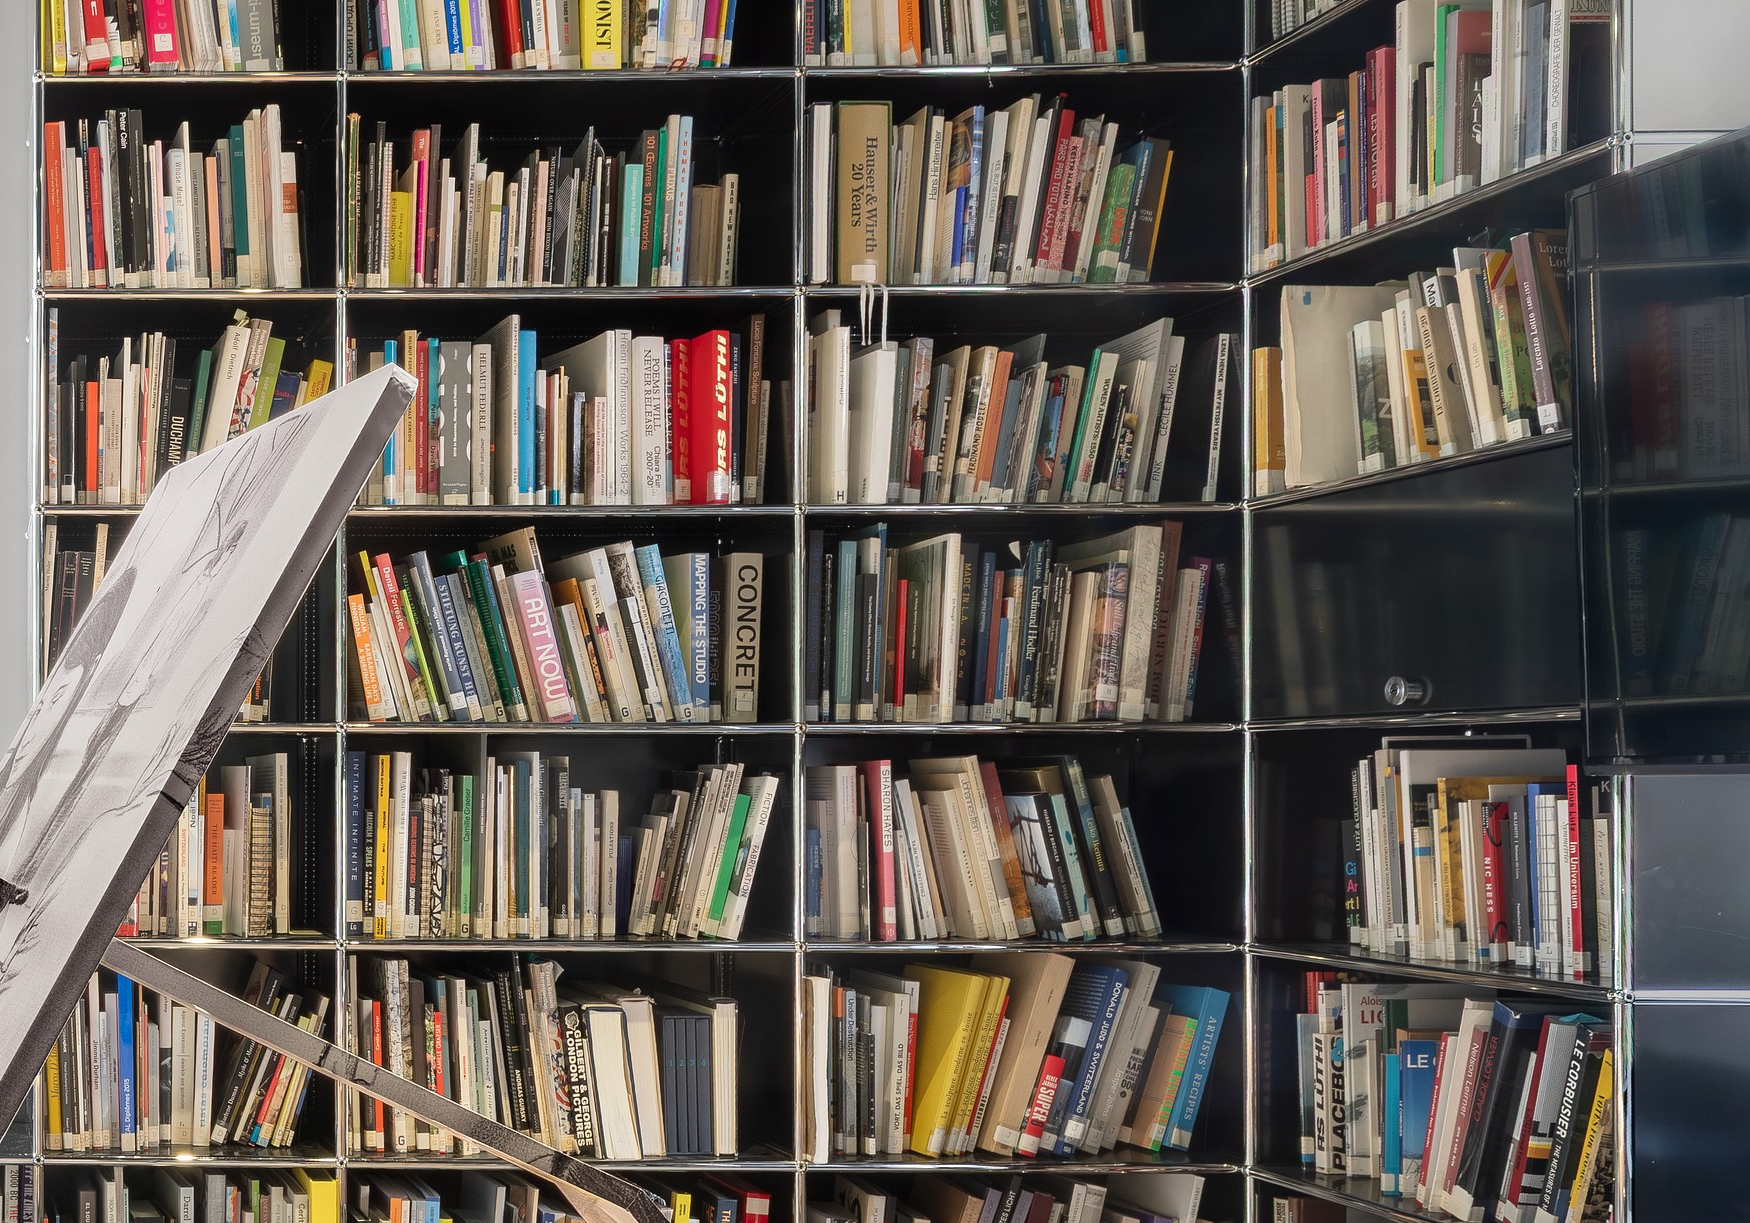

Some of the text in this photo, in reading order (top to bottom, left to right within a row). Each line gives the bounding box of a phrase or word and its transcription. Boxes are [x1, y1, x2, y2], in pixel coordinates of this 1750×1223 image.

[1554, 9, 1562, 36] GEWALT
[1552, 56, 1560, 108] CHOREOGRAFIE
[119, 111, 127, 130] Peter
[646, 136, 656, 149] 101
[641, 208, 651, 250] Artworks
[643, 193, 652, 206] 101
[675, 131, 688, 262] THOMAS FRONTINI
[851, 163, 864, 228] 20 Years
[866, 136, 879, 253] Hauser & Wirth
[168, 416, 185, 466] DUCHAMP
[524, 597, 565, 701] ART NOW
[696, 555, 707, 684] MAPPING THE STUDIO
[736, 564, 758, 694] CONCRET
[881, 768, 892, 847] SHARON HAYES
[1567, 781, 1578, 910] Klaus Lutz Im Universum
[1100, 1018, 1112, 1040] JUDD
[1108, 981, 1122, 1014] DONALD
[565, 1030, 585, 1147] LONDON PICTURES
[574, 1030, 593, 1146] GILBERT & GEORGE
[1074, 1052, 1101, 1114] SWITZERLAND
[1184, 1016, 1217, 1121] ARTISTS' RECIPES
[1555, 1039, 1586, 1138] LE CORBUSIER
